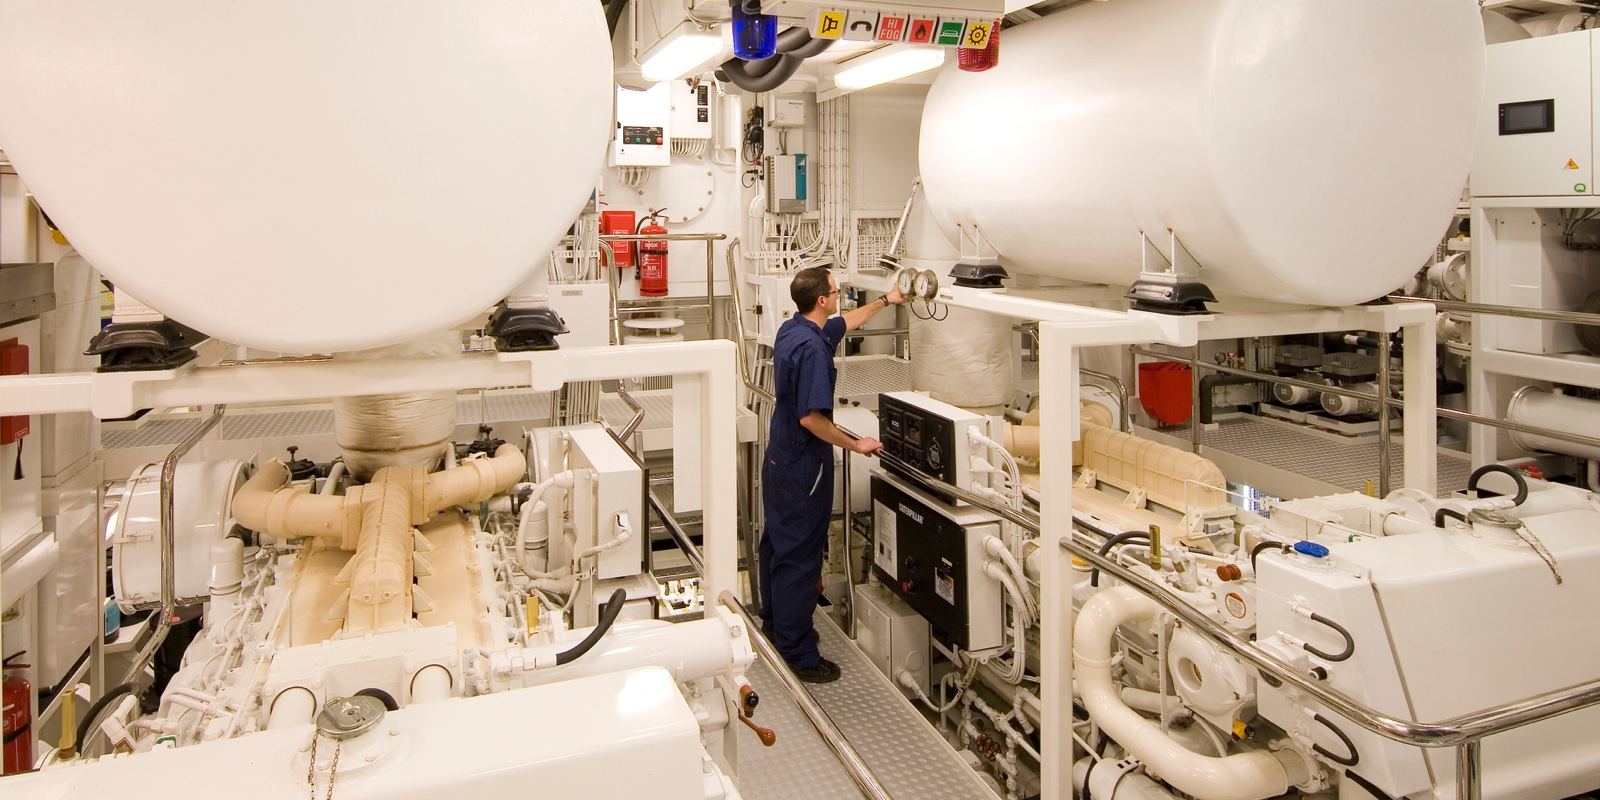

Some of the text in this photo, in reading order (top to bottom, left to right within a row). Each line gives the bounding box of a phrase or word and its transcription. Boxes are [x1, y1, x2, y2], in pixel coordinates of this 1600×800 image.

[887, 18, 898, 29] HI
[880, 29, 900, 40] FOG
[898, 502, 924, 525] CATERPILLAR
